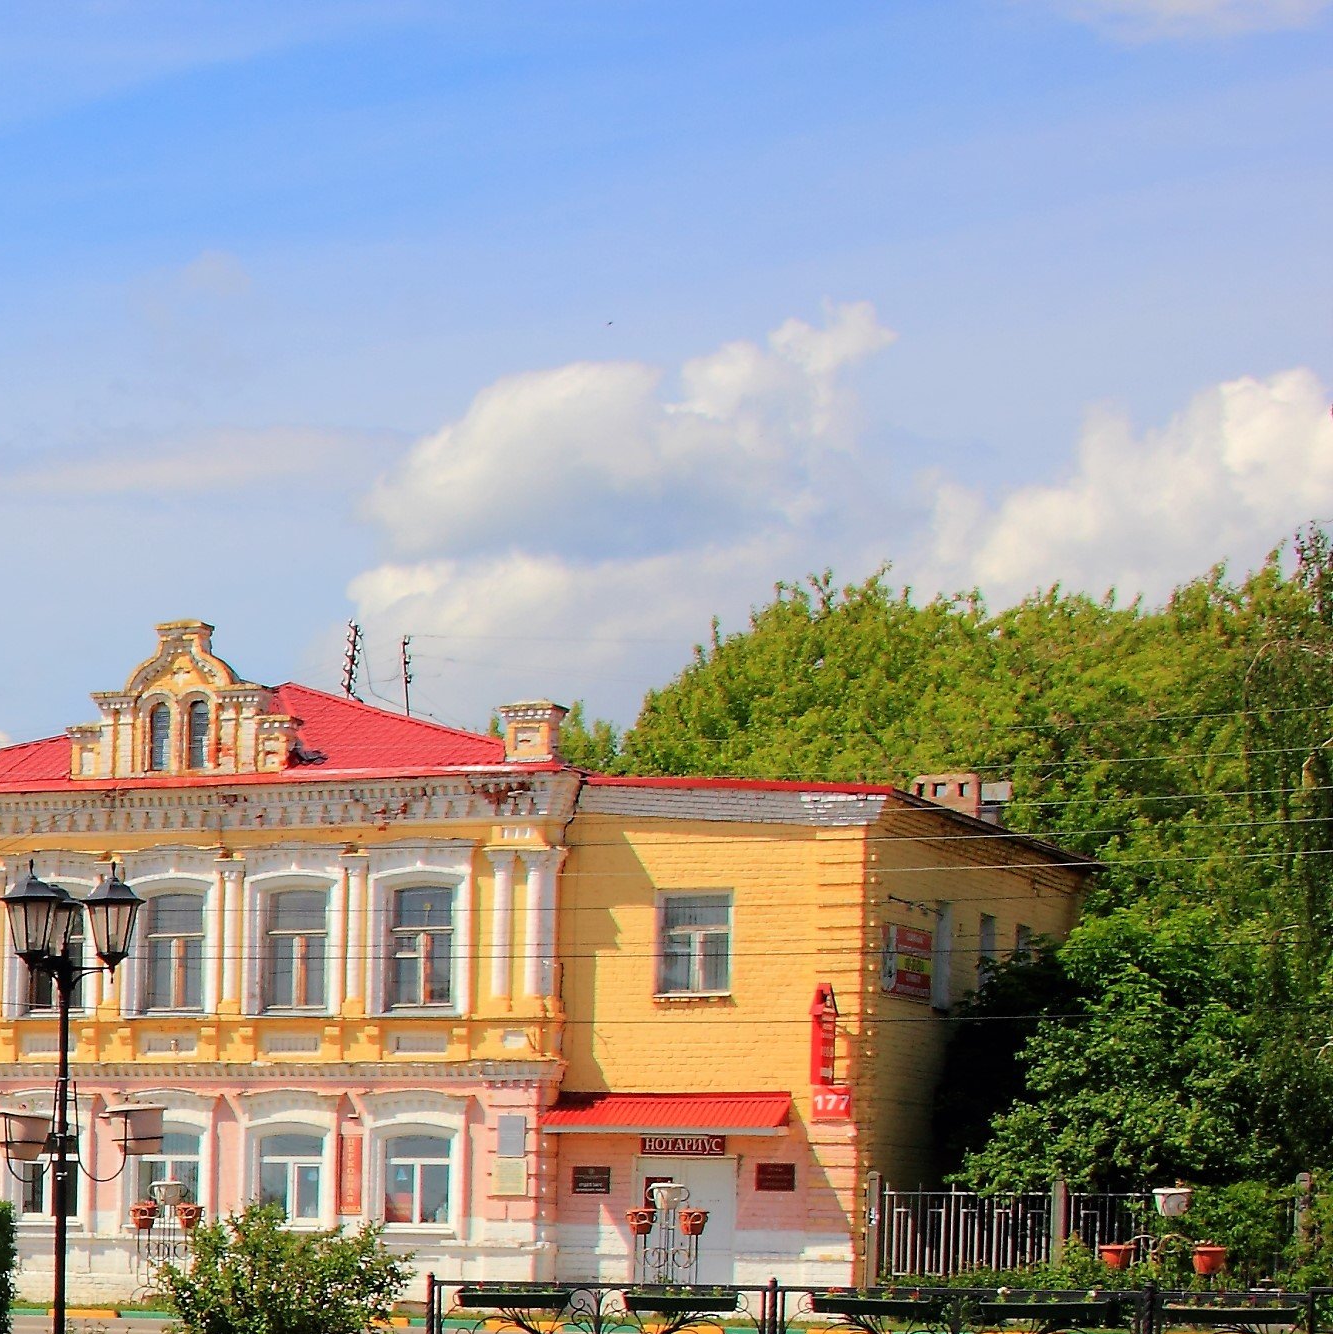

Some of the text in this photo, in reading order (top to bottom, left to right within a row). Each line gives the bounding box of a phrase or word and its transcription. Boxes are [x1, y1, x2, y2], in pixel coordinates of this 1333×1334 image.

[814, 1094, 850, 1111] 177
[644, 1137, 722, 1154] НОТАРИУС
[346, 1138, 355, 1203] ЦЕРКОВНАЯ
